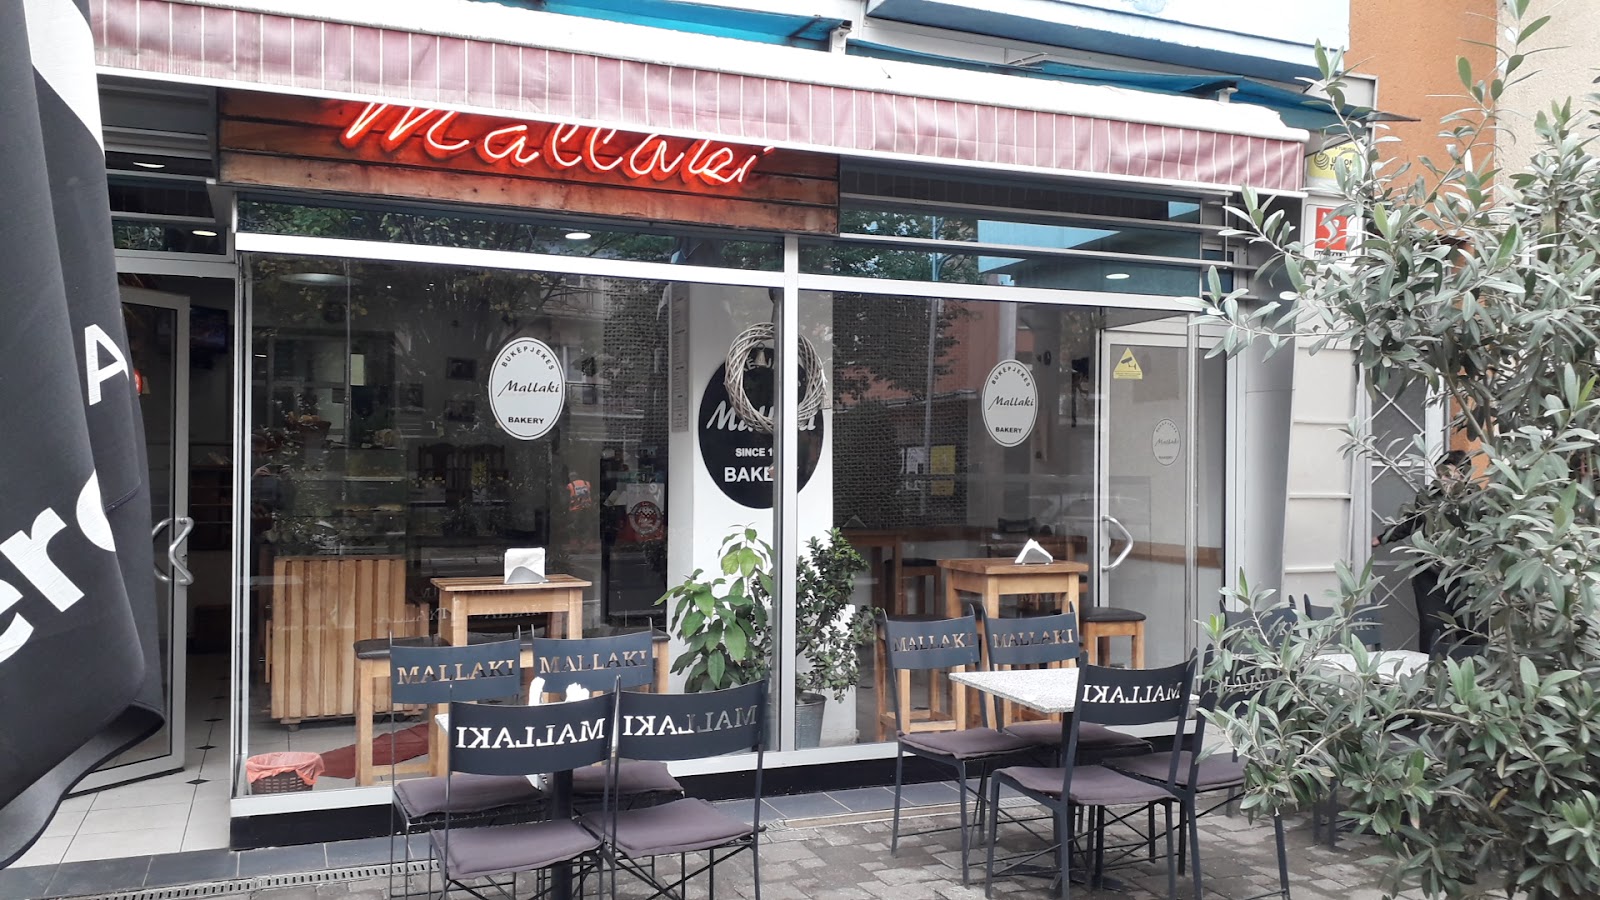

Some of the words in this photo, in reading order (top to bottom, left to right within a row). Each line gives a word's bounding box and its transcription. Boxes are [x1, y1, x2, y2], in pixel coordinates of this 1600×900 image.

[497, 379, 561, 398] Mallaki
[988, 395, 1035, 411] Mallaki
[507, 416, 545, 425] BAKERY
[995, 426, 1023, 434] BAKERY
[735, 447, 766, 457] SINCE
[724, 466, 775, 482] BAKE
[892, 632, 976, 652] MALLAKI
[992, 628, 1074, 649] MALLAKI
[538, 649, 648, 675] MALLAKI
[396, 659, 516, 686] MALLAKI
